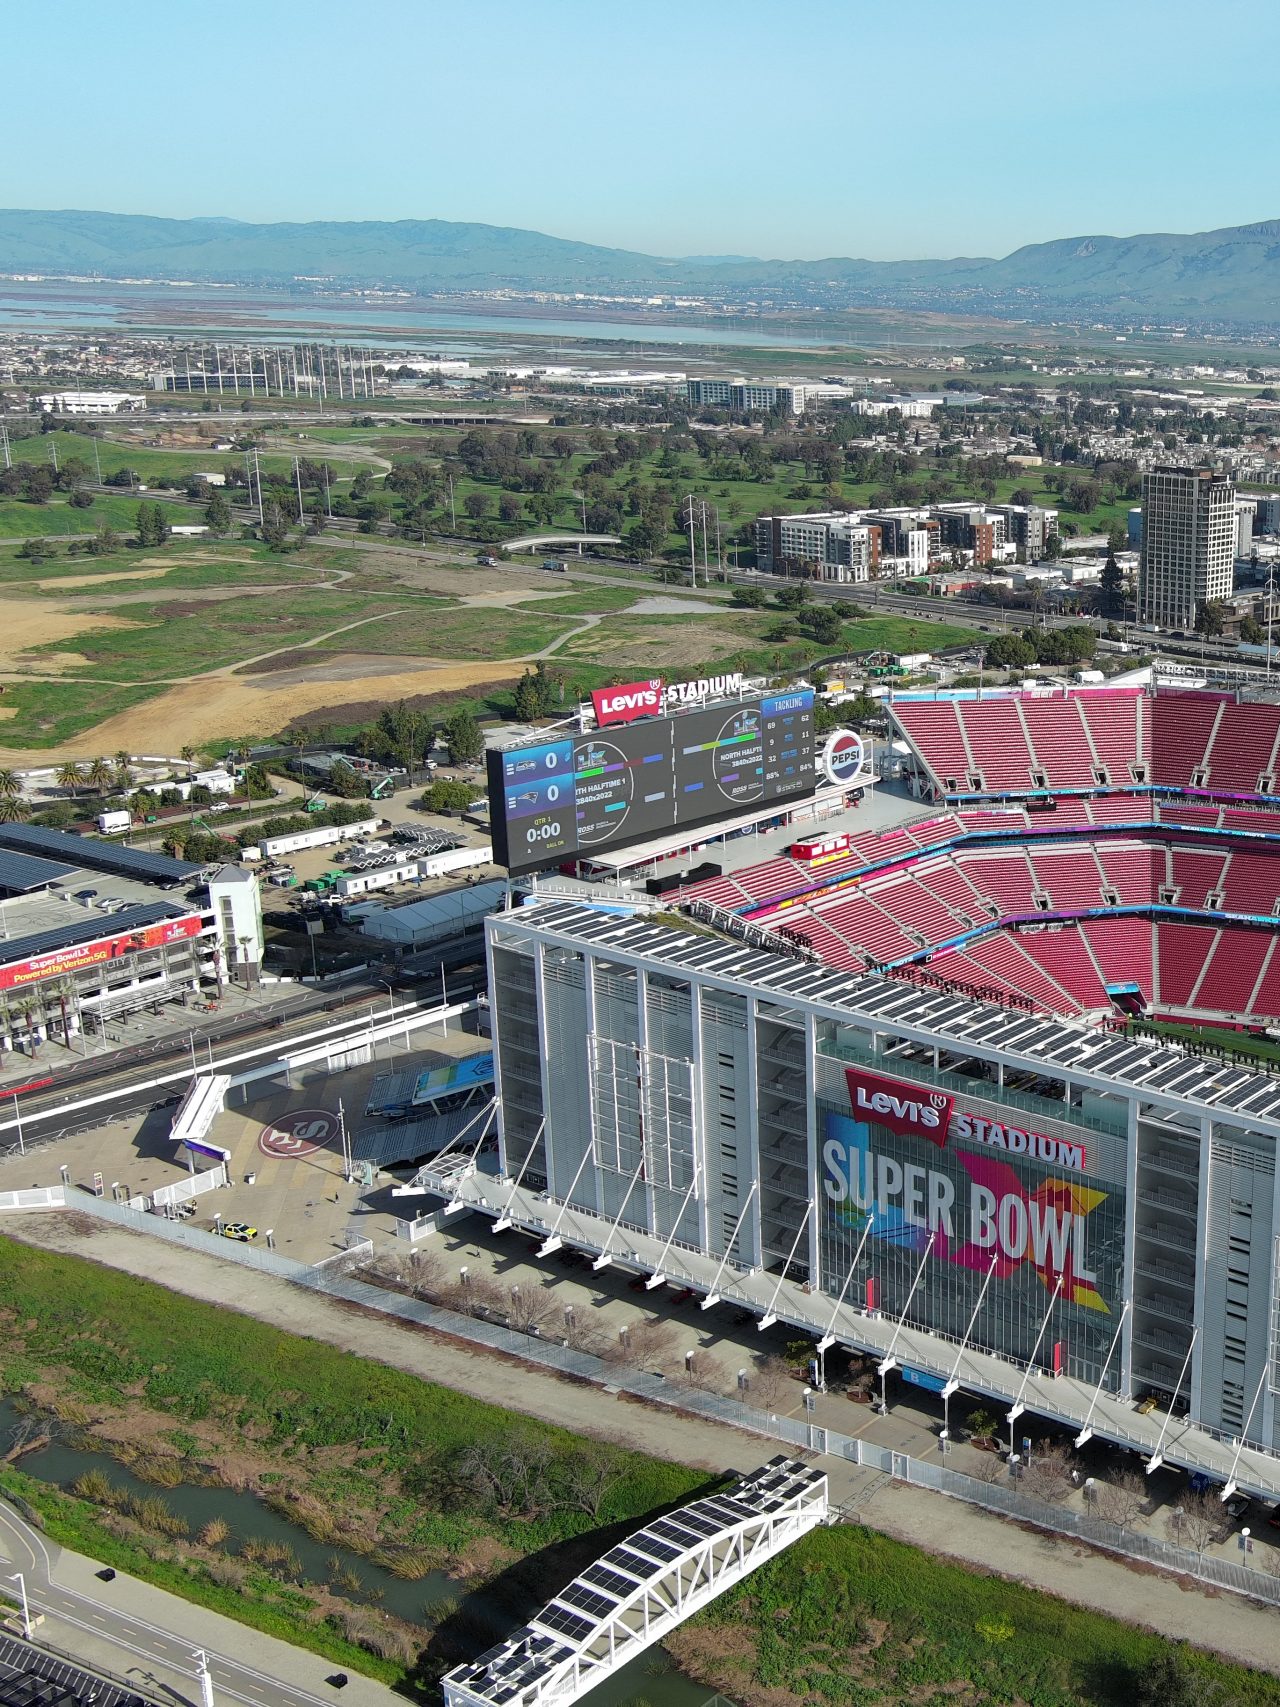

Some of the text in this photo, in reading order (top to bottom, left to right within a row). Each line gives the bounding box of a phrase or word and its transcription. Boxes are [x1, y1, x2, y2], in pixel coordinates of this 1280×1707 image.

[667, 673, 742, 701] STADIUM
[775, 696, 802, 712] TACKLING
[546, 752, 558, 768] 0
[720, 750, 741, 761] NORTH
[832, 750, 859, 765] PEPSI
[548, 785, 559, 801] 0
[588, 779, 621, 793] HALFTIME
[732, 786, 747, 794] ROSS
[534, 817, 546, 826] QTR
[578, 824, 595, 834] ROSS
[526, 823, 561, 842] 0:00
[14, 951, 107, 983] Powered by Verizon 5G
[30, 948, 90, 970] Super Bowl LX
[107, 957, 125, 968] CITY
[956, 1114, 1085, 1169] STADIUM
[822, 1138, 1097, 1283] SUPER BOWL
